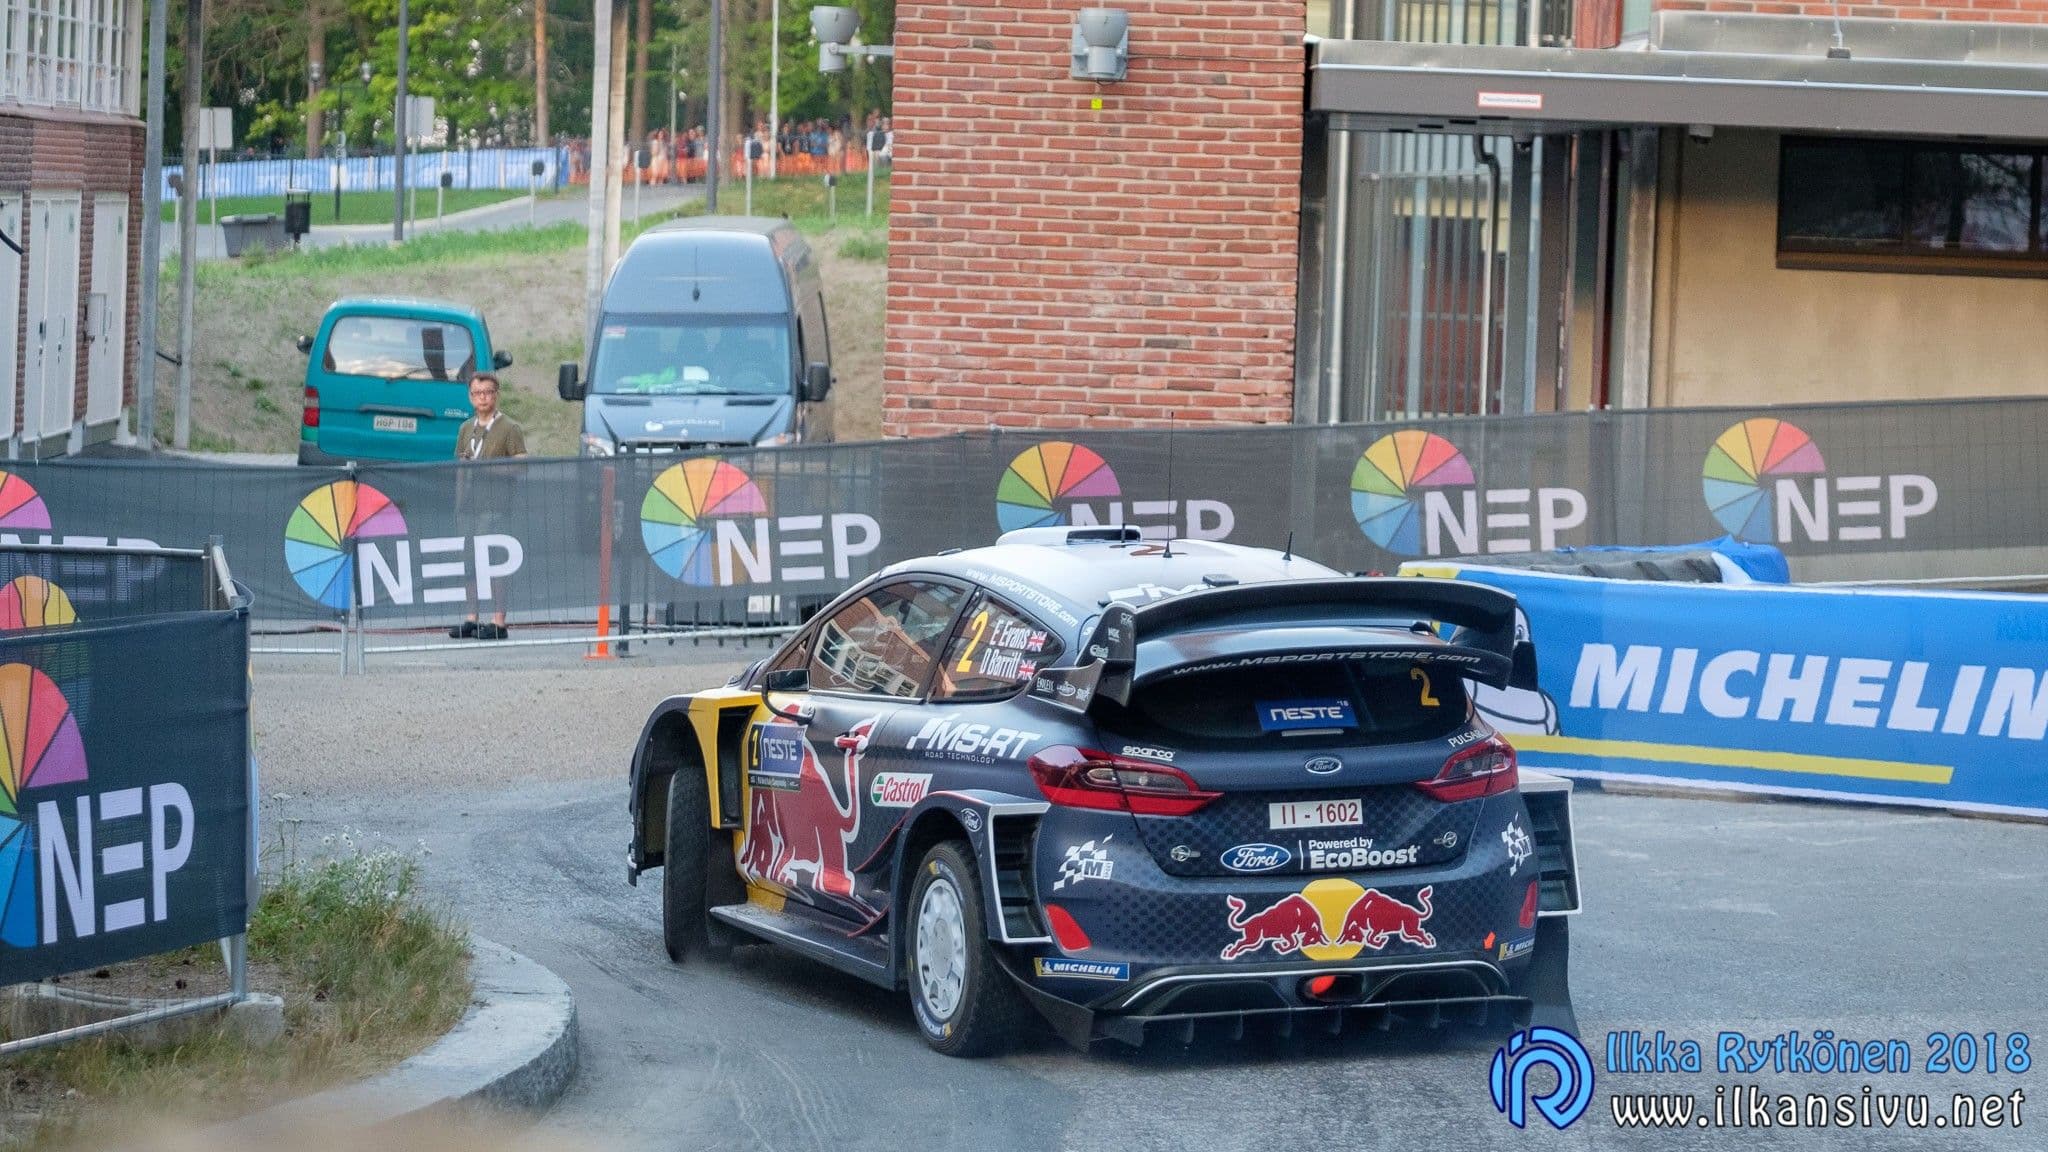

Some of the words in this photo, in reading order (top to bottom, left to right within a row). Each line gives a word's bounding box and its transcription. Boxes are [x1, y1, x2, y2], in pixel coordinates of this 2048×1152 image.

[1776, 474, 1938, 543] NEP
[1424, 488, 1587, 555] NEP
[716, 513, 881, 586] NEP
[358, 534, 523, 607] NEP
[956, 611, 988, 673] 2
[989, 619, 1003, 646] E
[999, 620, 1031, 650] Evans
[1173, 651, 1481, 676] www.MSPORTSTORE.com
[1410, 667, 1441, 706] 2
[1570, 642, 2048, 741] MICHELIN
[1271, 706, 1344, 721] NESTE
[762, 737, 798, 761] NESTE
[947, 752, 996, 765] TECHNOLOGY
[1122, 745, 1176, 761] sparco
[883, 776, 926, 802] Castrol
[1316, 802, 1359, 824] 1602
[1308, 838, 1358, 850] Powered
[1359, 837, 1374, 850] by
[38, 782, 195, 945] NEP
[1233, 848, 1280, 868] Ford
[1310, 846, 1417, 870] EcoBoost
[1053, 962, 1121, 976] MICHELIN
